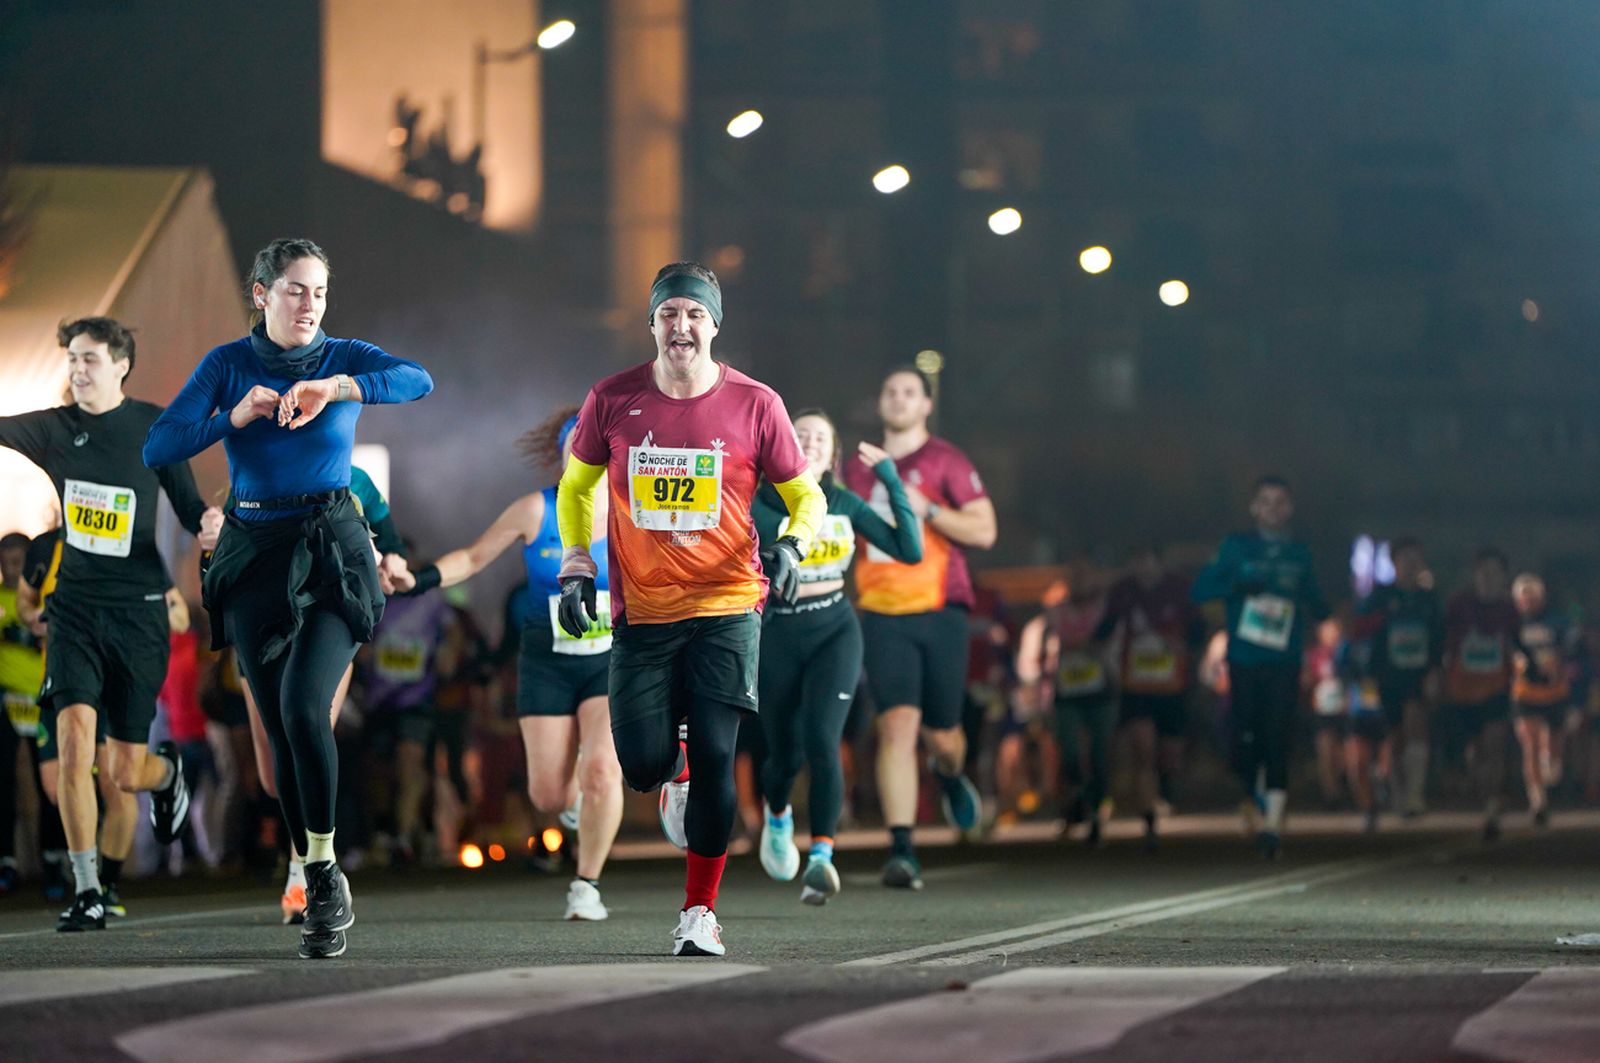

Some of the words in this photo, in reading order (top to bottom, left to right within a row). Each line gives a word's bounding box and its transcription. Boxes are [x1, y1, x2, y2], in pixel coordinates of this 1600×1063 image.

[648, 457, 676, 466] NOCHE
[677, 457, 688, 466] DE
[638, 466, 655, 476] SAN
[657, 466, 687, 476] ANTÓN
[654, 477, 695, 502] 972
[75, 506, 118, 531] 7830
